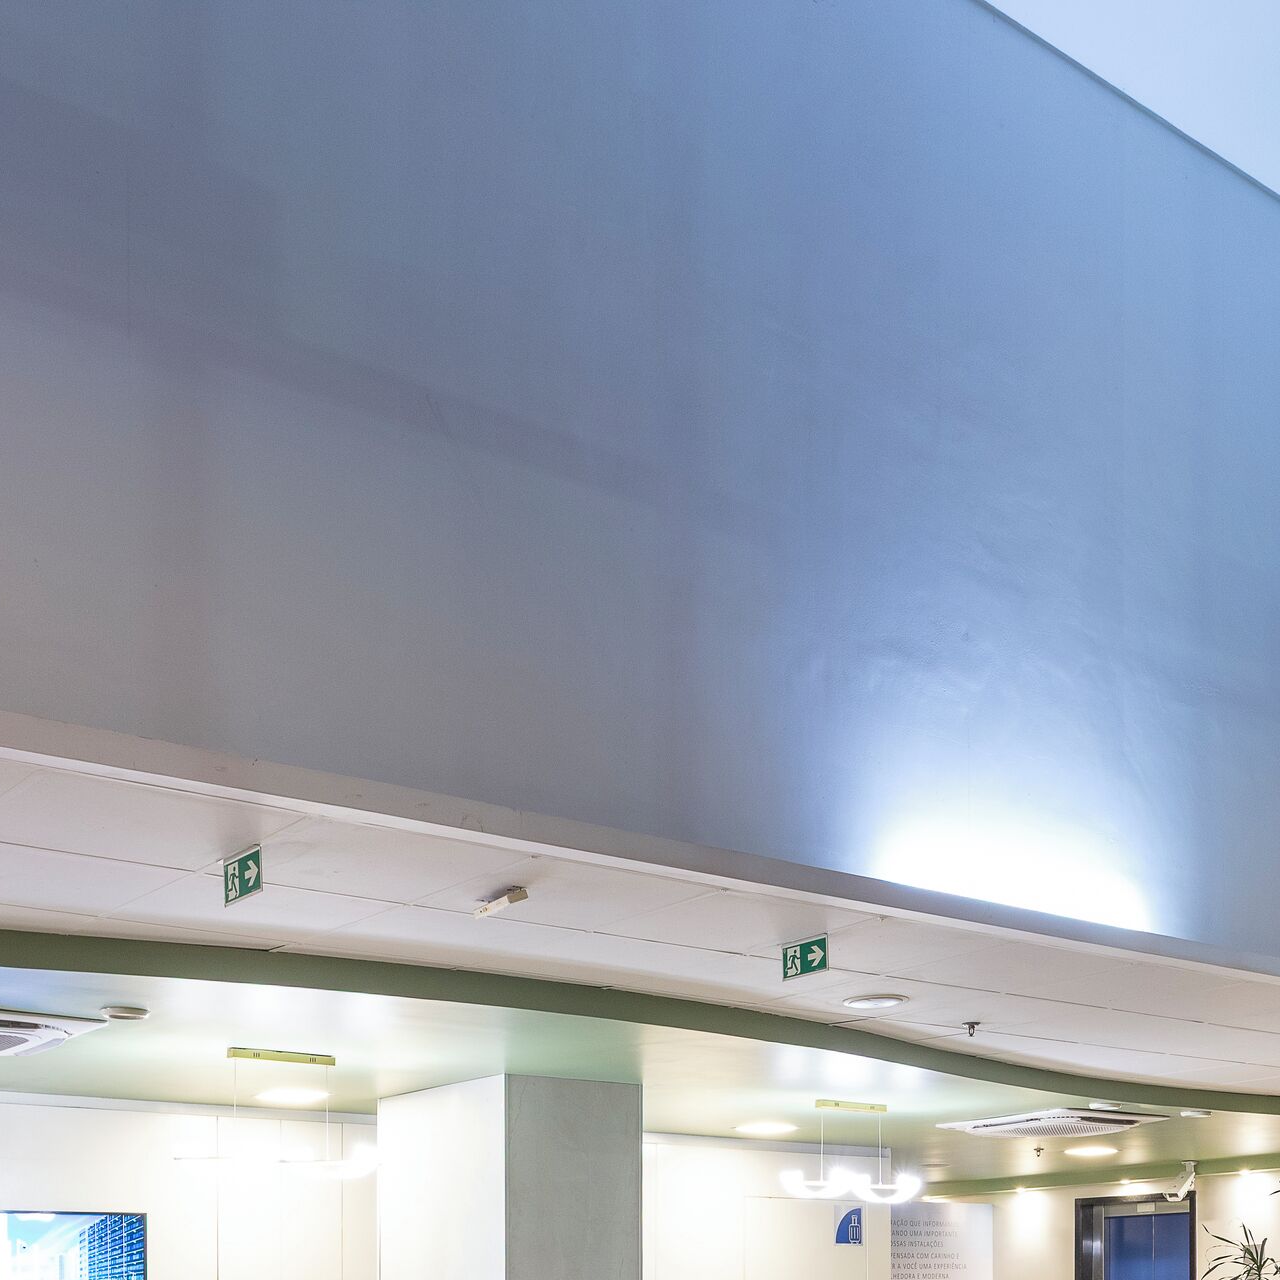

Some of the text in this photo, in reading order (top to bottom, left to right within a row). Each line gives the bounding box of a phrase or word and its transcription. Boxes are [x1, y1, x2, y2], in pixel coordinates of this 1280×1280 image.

[891, 1218, 908, 1228] AÇÃO
[909, 1220, 921, 1228] QUE
[908, 1240, 943, 1248] INSTALAÇÕES
[916, 1252, 929, 1260] COM
[931, 1252, 955, 1260] CARINHO
[903, 1262, 917, 1270] VOCÊ
[933, 1262, 967, 1270] EXPERIÊNCIA
